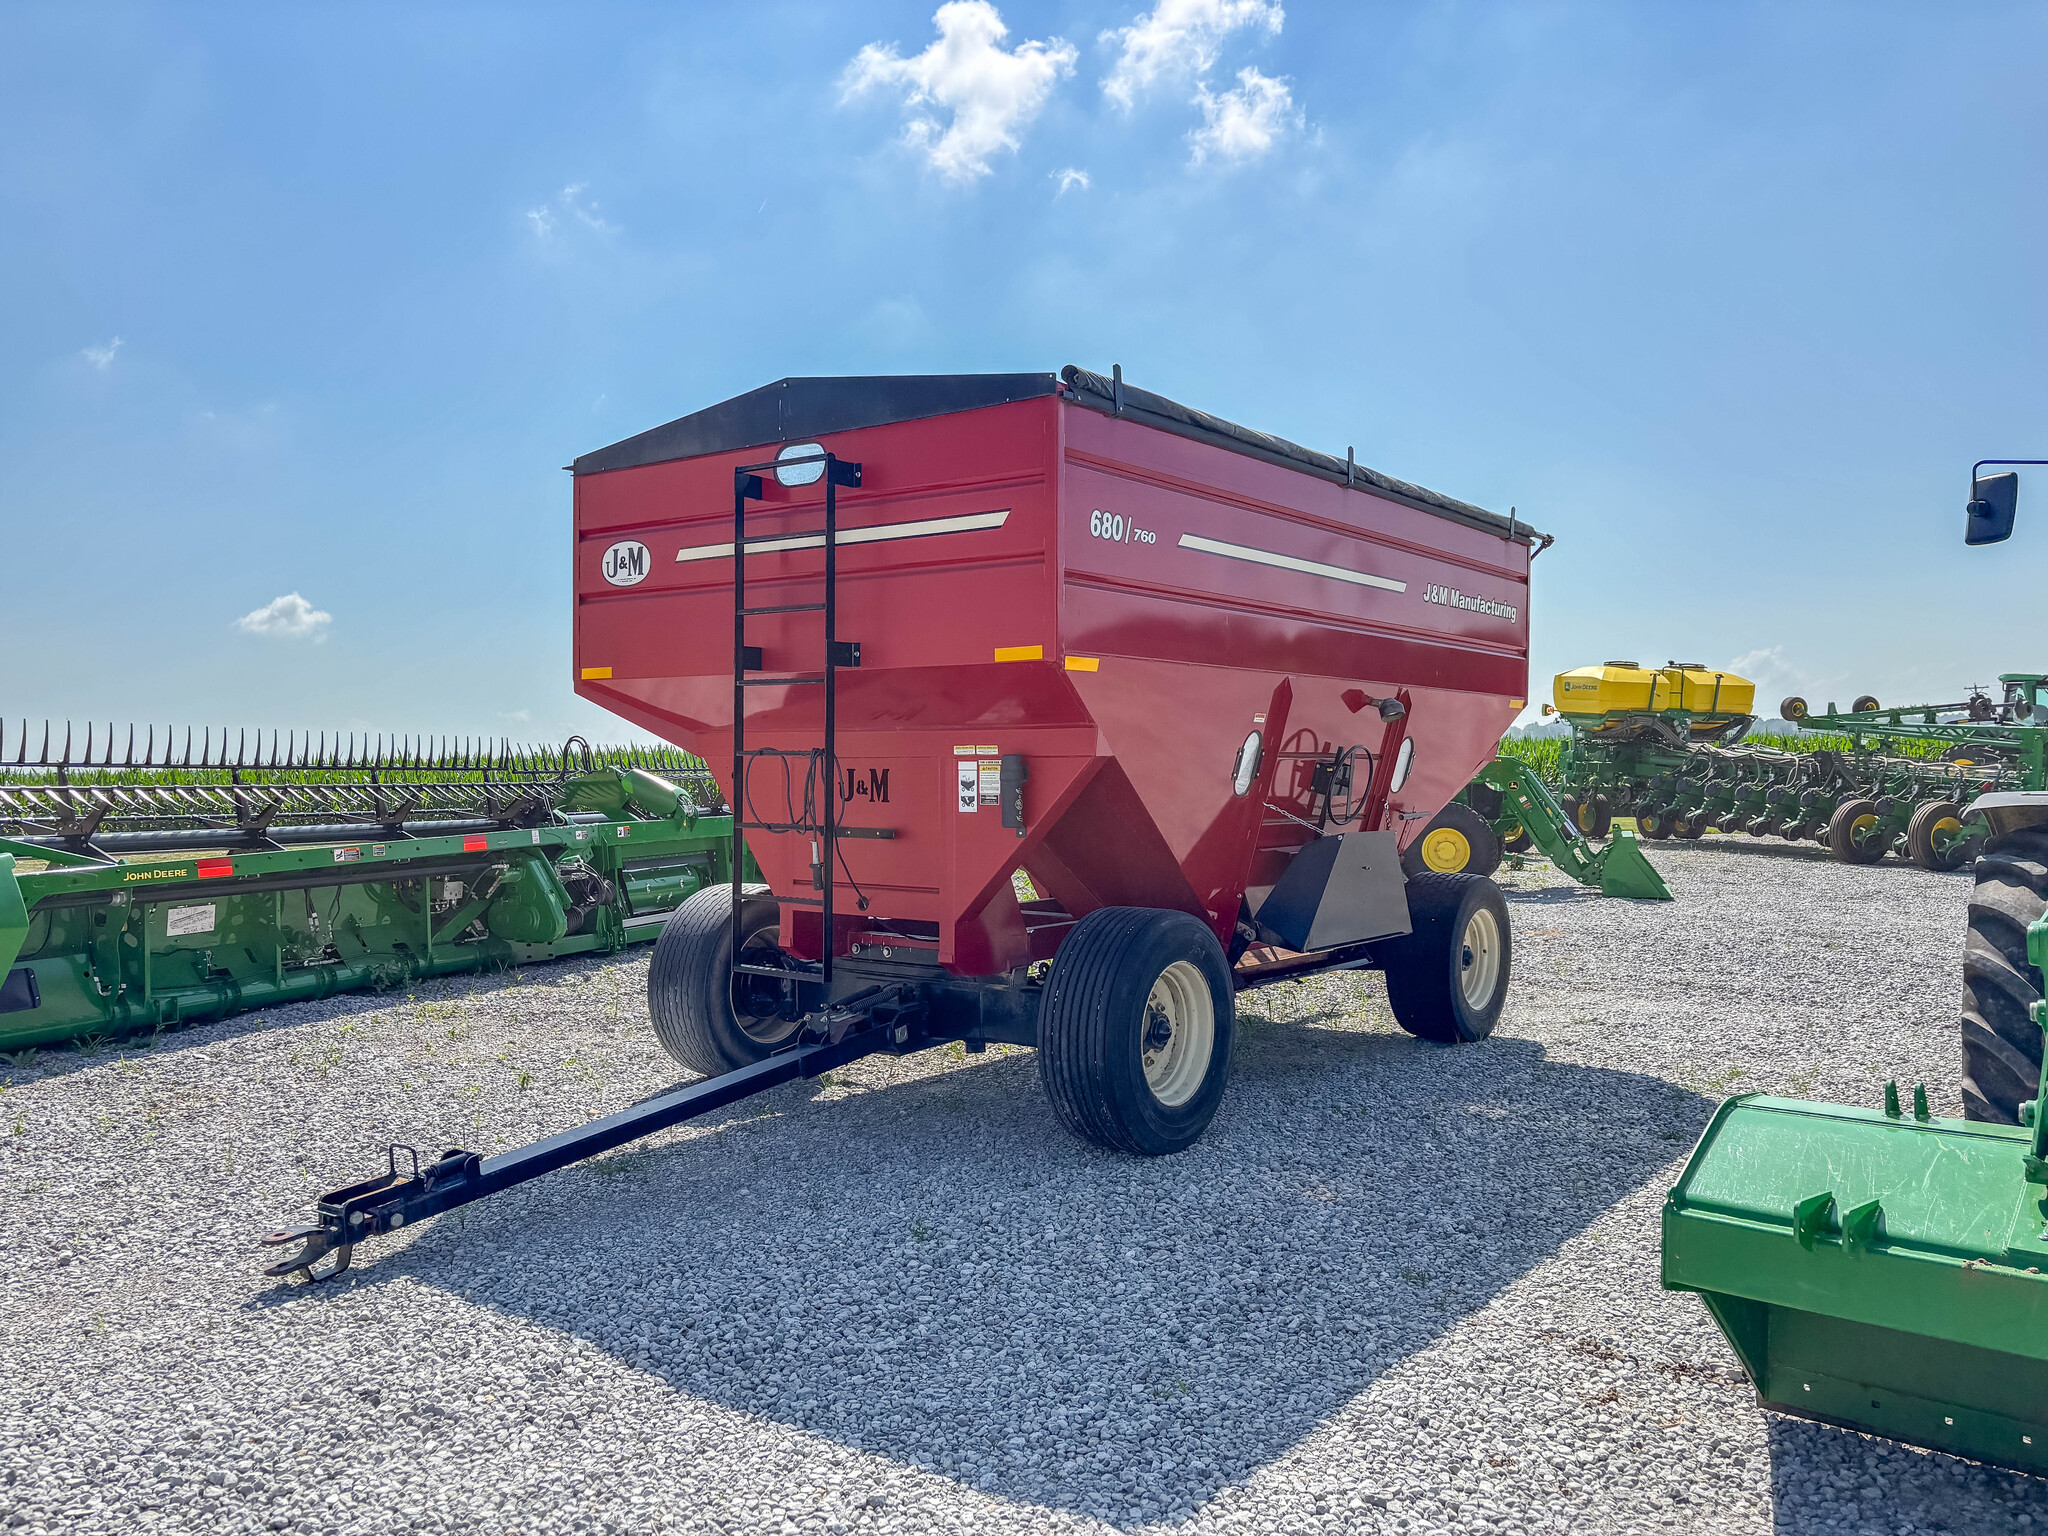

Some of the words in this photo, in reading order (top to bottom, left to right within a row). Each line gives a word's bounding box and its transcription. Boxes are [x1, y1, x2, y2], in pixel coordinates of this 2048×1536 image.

[605, 546, 644, 578] J&M
[1423, 582, 1448, 606] J&M
[1450, 588, 1517, 624] Manufacturing
[838, 769, 890, 802] J&M
[124, 872, 152, 881] JOHN
[154, 869, 188, 879] DEERE
